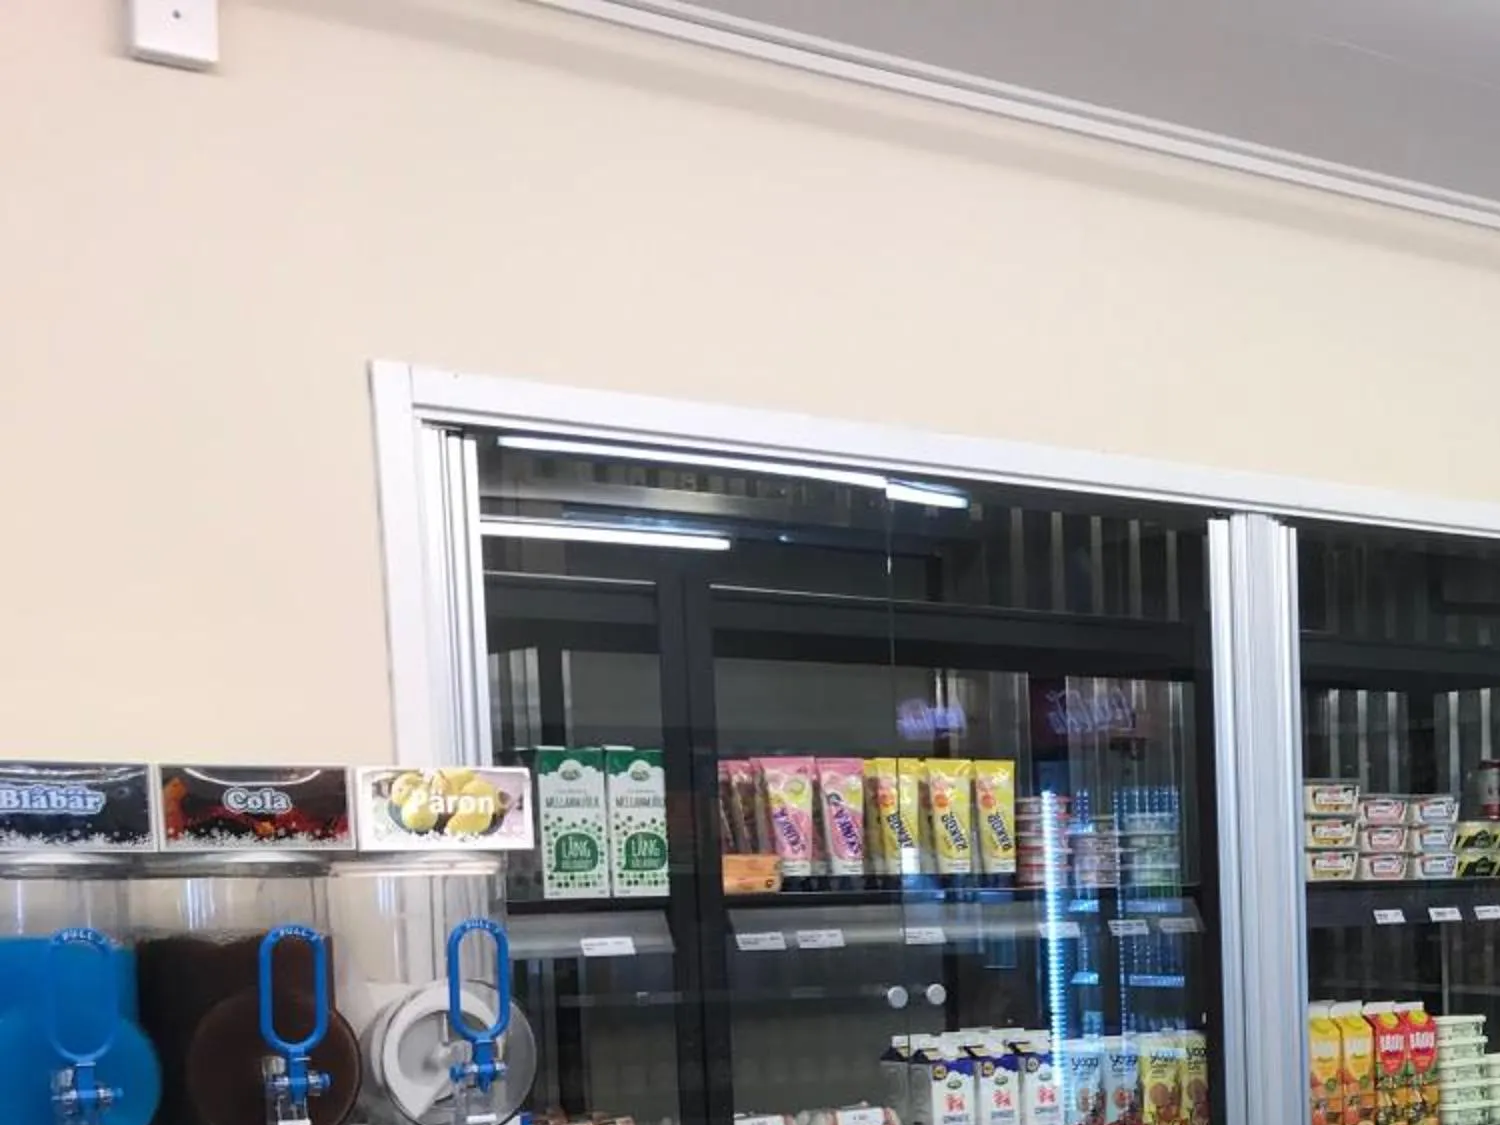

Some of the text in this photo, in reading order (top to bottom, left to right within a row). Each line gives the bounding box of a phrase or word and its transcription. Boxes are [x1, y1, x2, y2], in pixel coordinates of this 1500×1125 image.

[0, 785, 101, 811] Blåbär
[225, 788, 291, 812] Cola
[408, 786, 493, 814] Päron
